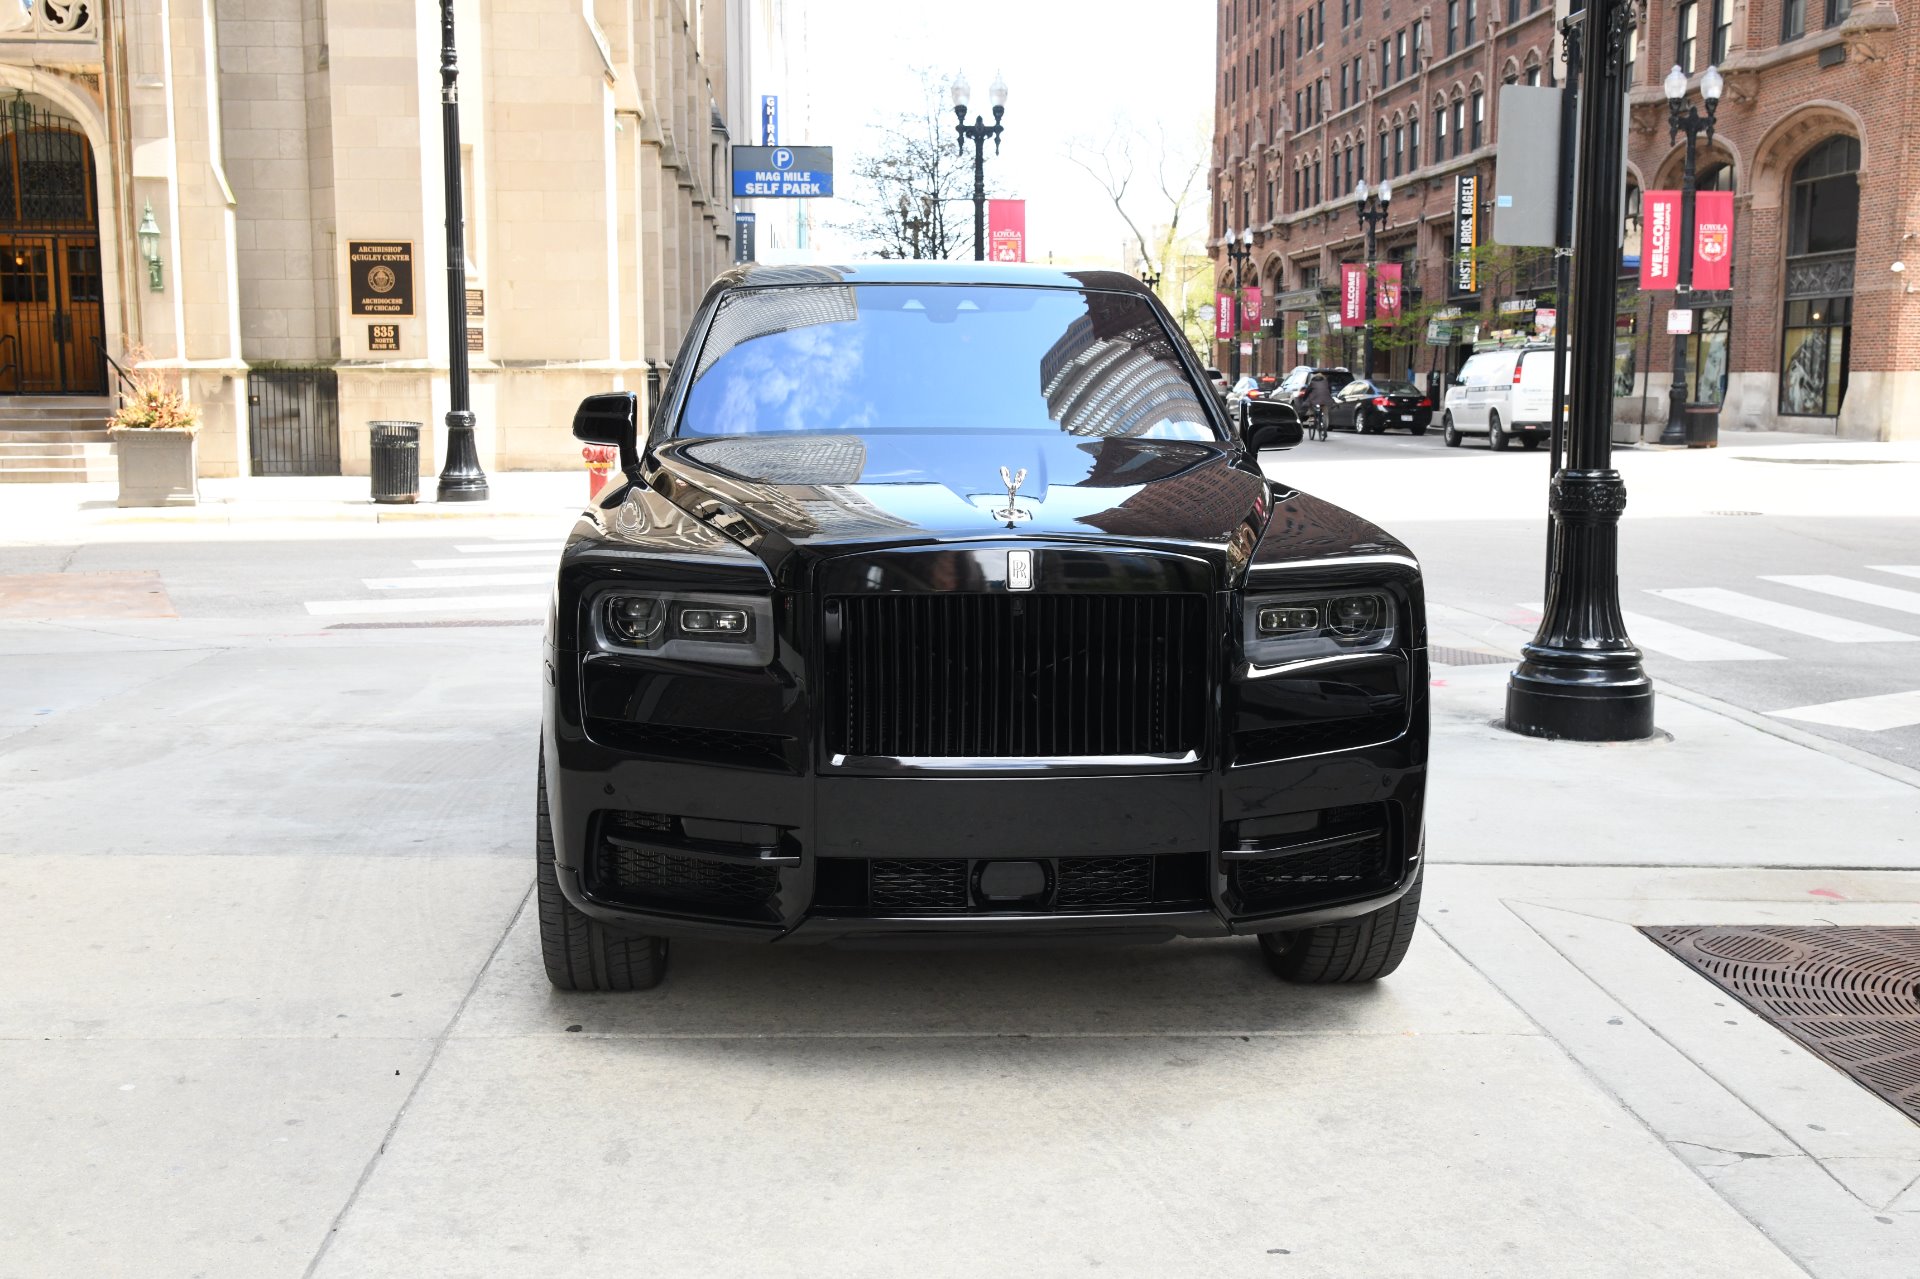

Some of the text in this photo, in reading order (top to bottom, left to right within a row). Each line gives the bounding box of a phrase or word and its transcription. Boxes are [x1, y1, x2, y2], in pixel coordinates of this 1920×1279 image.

[755, 172, 811, 182] MAG MILE
[745, 183, 820, 194] SELF PARK
[1462, 178, 1474, 215] BAGELS
[1651, 202, 1665, 277] WELCOME
[351, 254, 381, 262] QUIGLEY
[1347, 271, 1356, 319] WELCOME
[374, 326, 394, 338] 835
